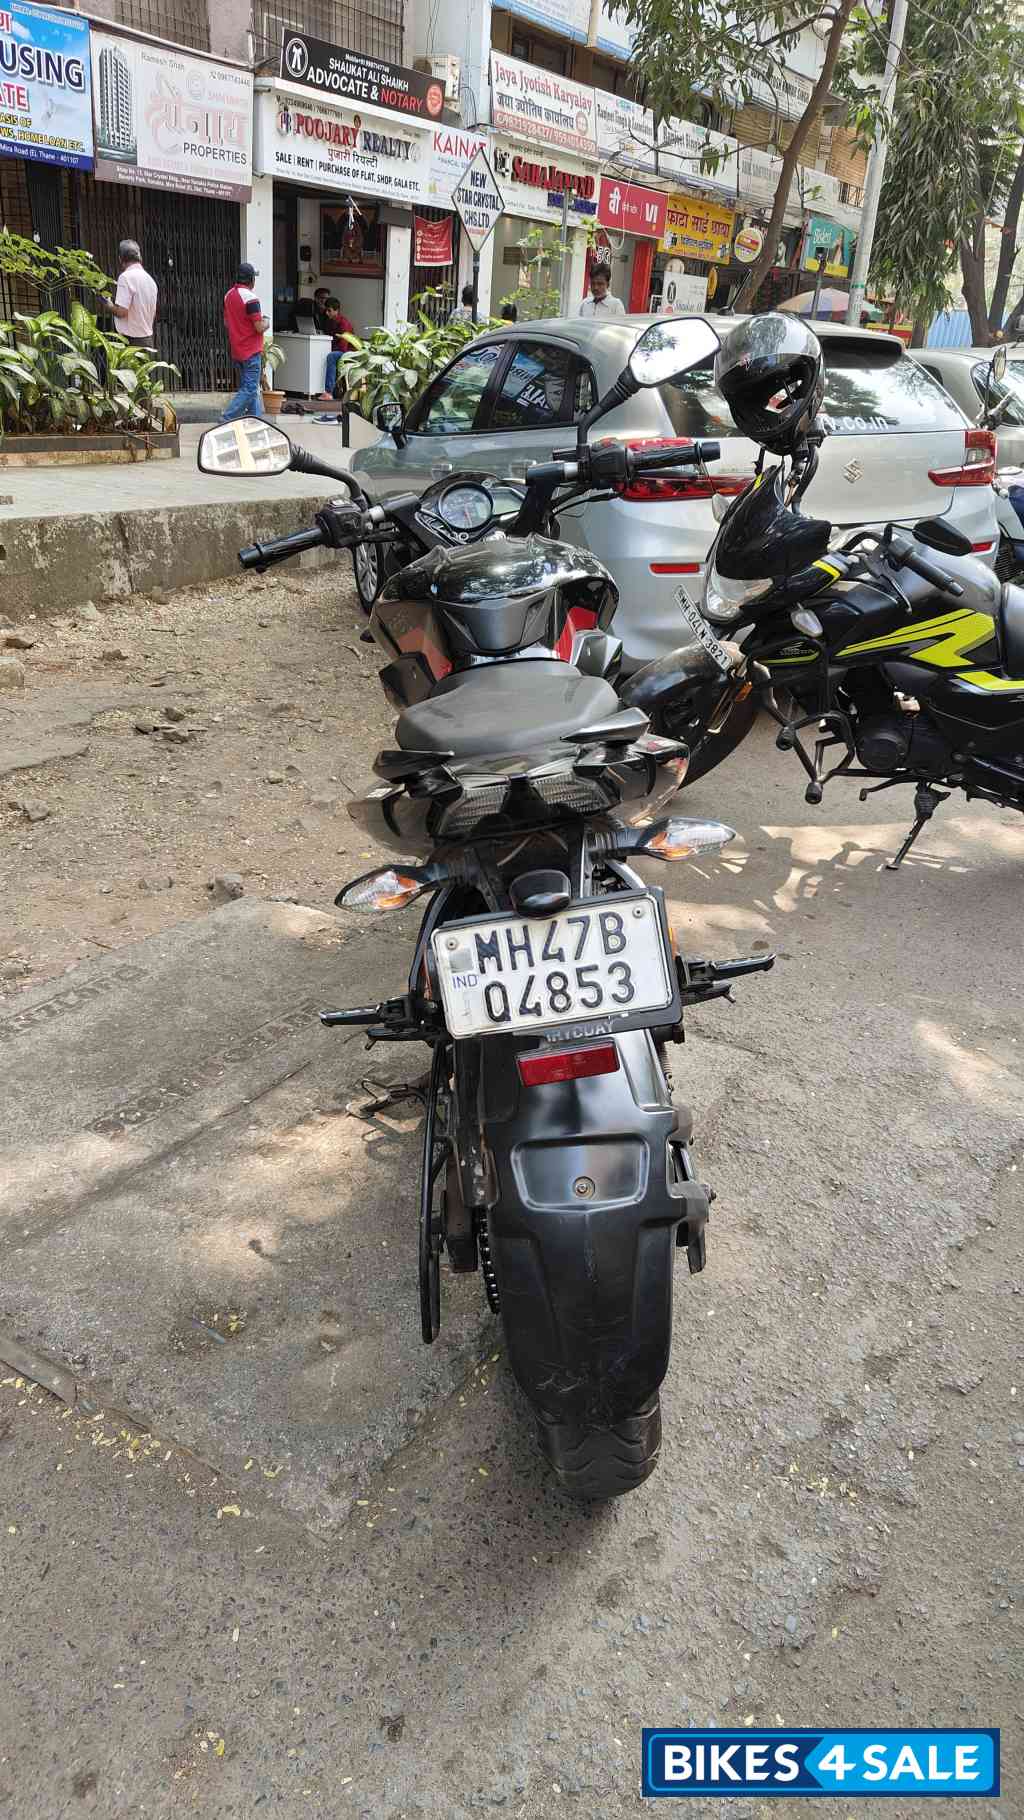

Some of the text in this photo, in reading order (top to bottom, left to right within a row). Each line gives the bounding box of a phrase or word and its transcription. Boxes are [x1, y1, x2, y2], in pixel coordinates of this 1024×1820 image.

[306, 66, 423, 113] ADVOCATE & NOTARY
[329, 57, 367, 79] SHAUKAT
[368, 68, 380, 84] ALI
[381, 73, 409, 92] SHAIKH
[495, 60, 518, 87] Jaya
[519, 70, 552, 97] Jyotish
[553, 83, 593, 115] Karyalay
[183, 142, 247, 165] PROPERTIES
[294, 112, 412, 161] POOJARY REALTY
[275, 151, 293, 166] SALE
[297, 155, 314, 168] RENT
[319, 161, 351, 178] PURCHASE
[352, 168, 360, 179] OF
[361, 171, 376, 184] FLAT,
[394, 177, 408, 189] GALA
[409, 180, 421, 192] ETC.
[470, 170, 487, 189] NEW
[452, 974, 478, 989] IND
